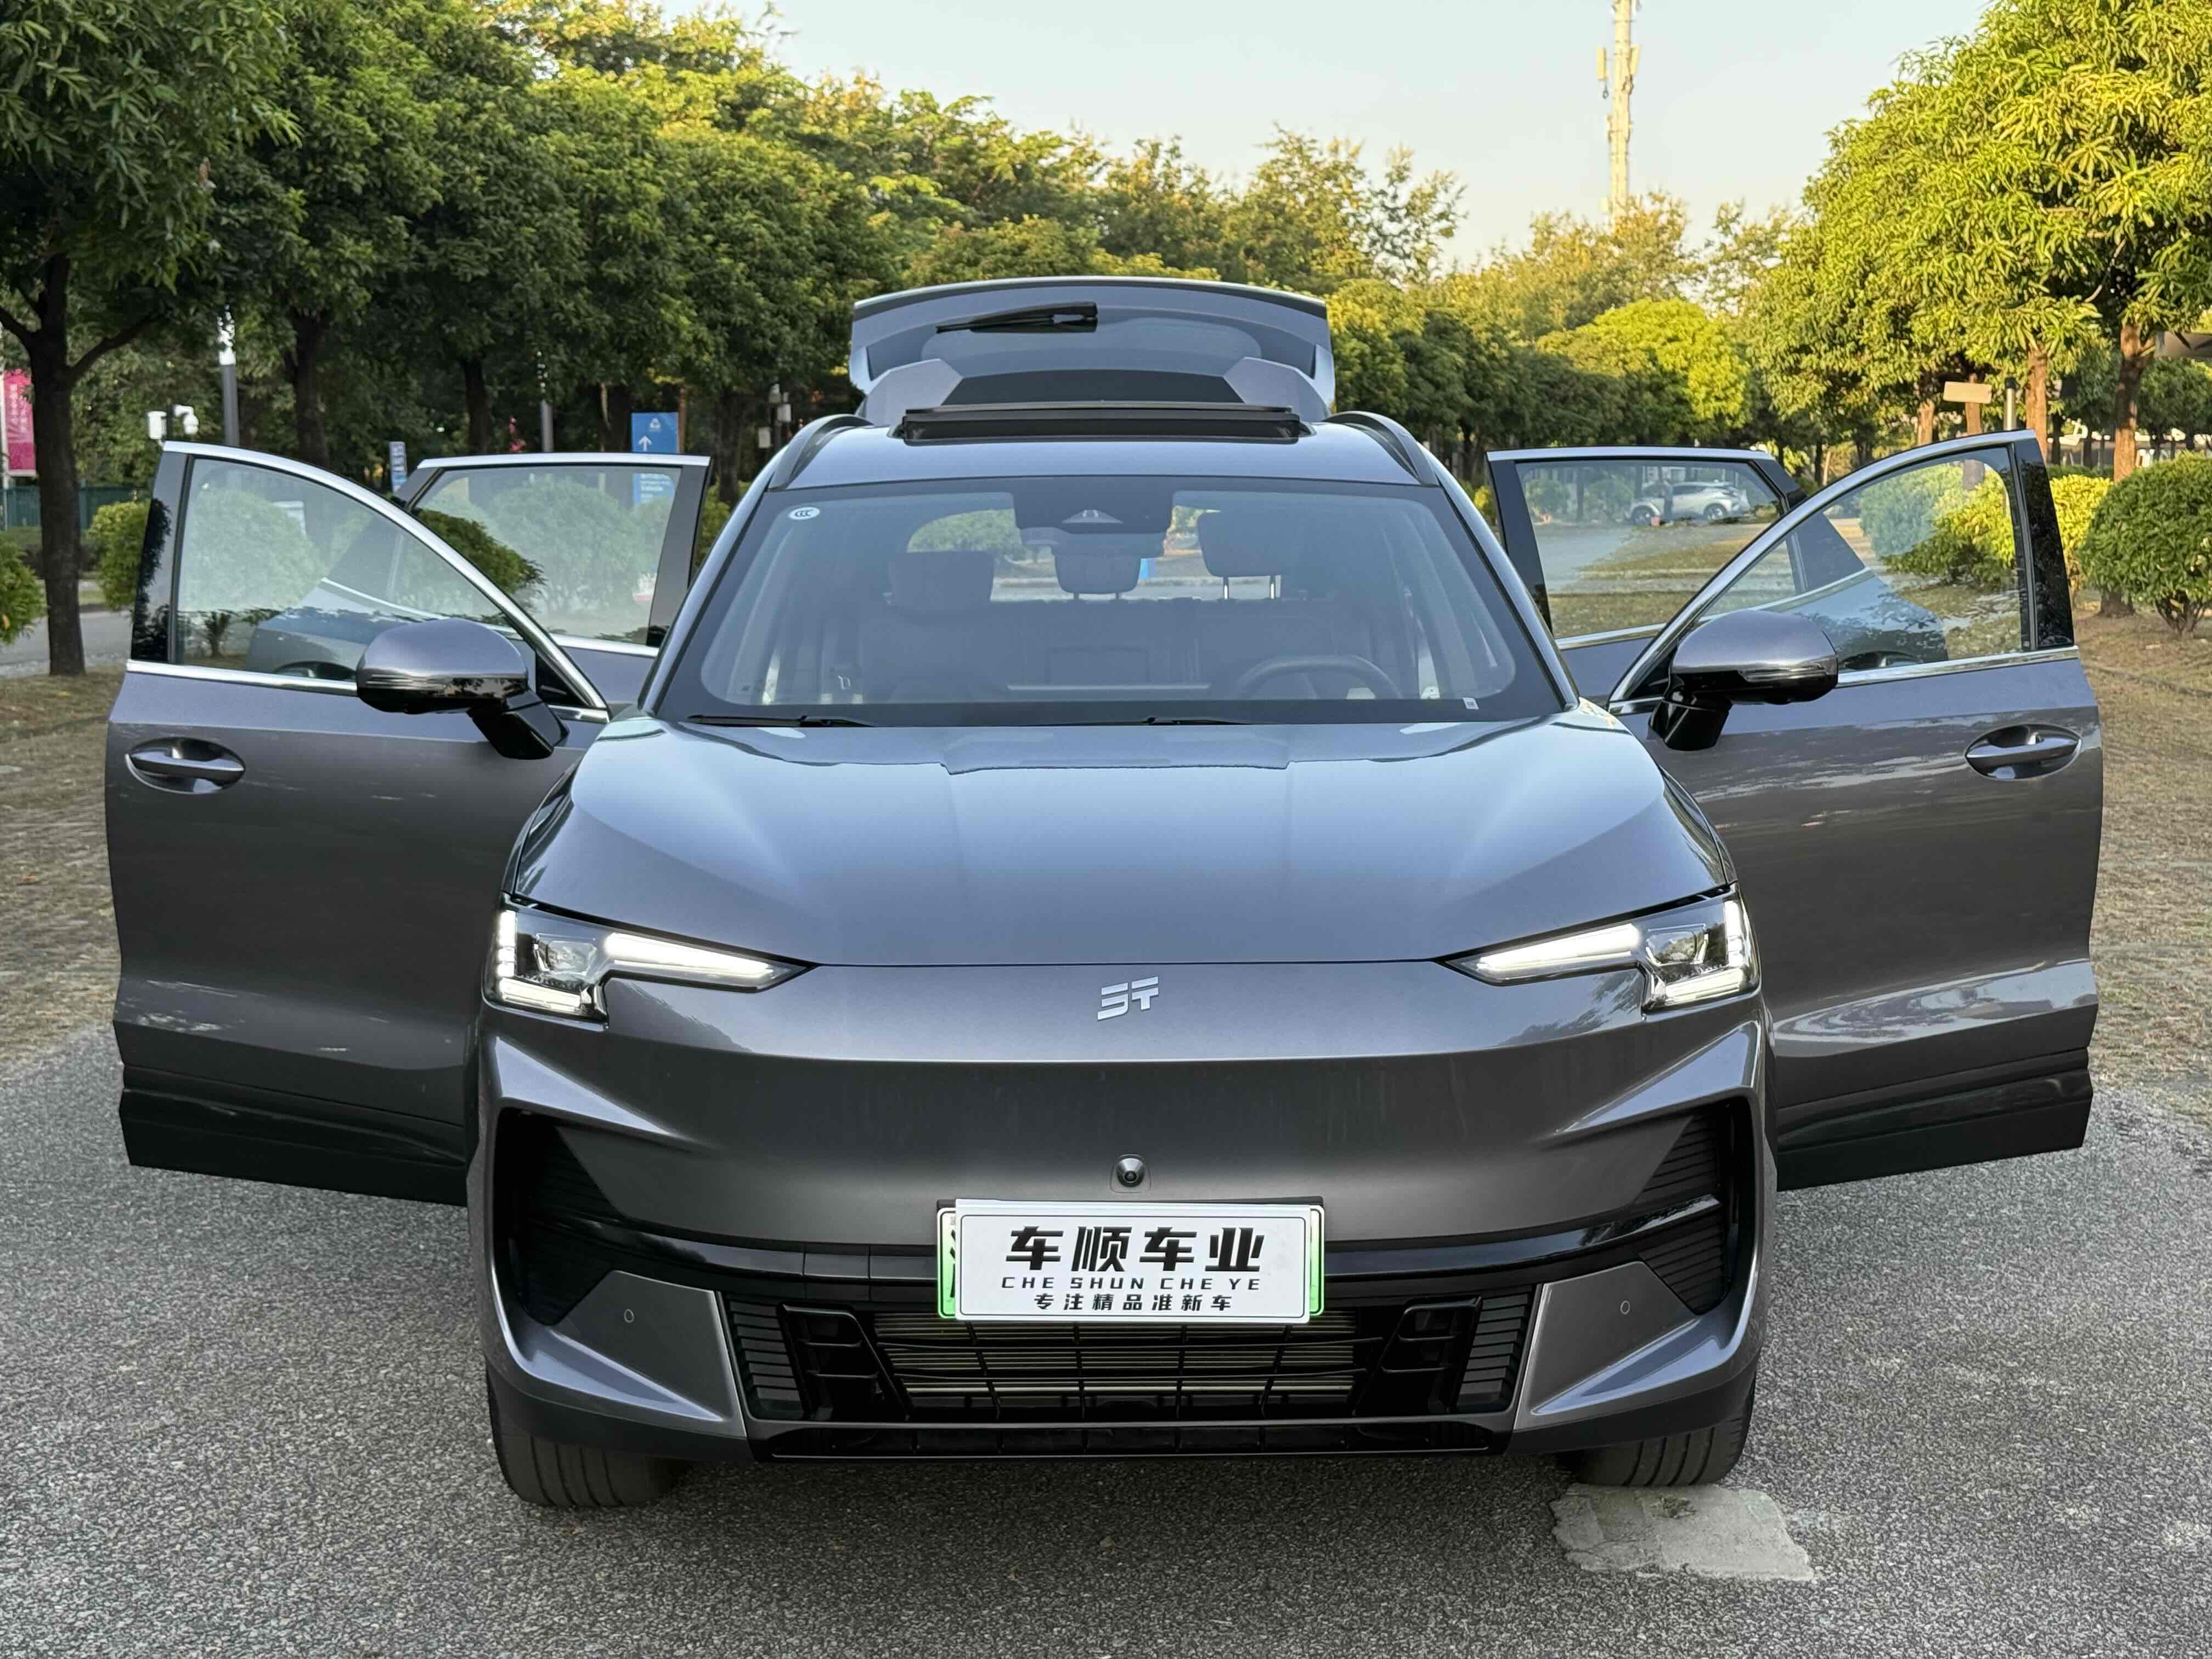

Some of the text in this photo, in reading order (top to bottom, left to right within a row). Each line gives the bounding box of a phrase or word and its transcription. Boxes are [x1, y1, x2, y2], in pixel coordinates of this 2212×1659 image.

[1006, 1226, 1265, 1272] 车顺车业
[1001, 1277, 1260, 1290] CHE SHUN CHE YE
[1034, 1293, 1232, 1311] 专注精品准新车
